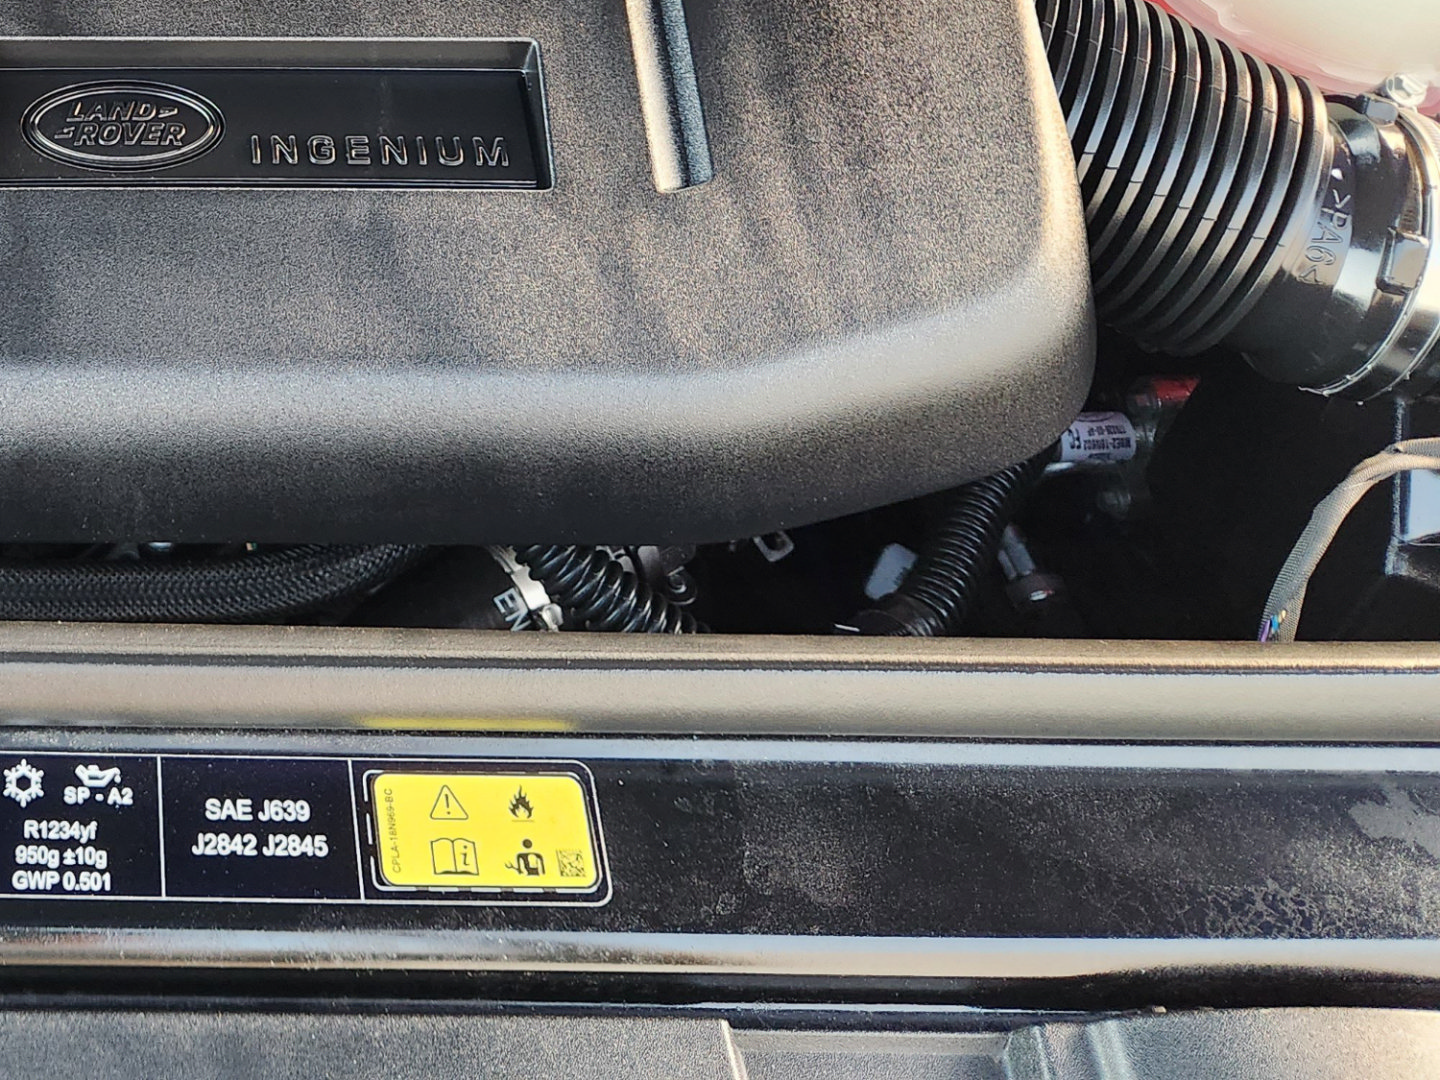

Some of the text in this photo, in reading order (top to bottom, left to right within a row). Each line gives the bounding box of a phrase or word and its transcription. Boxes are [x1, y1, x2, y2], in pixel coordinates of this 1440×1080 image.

[65, 101, 159, 122] LAND
[73, 121, 187, 147] ROVER
[250, 133, 510, 167] INGENIUM
[63, 787, 92, 805] SP
[106, 788, 134, 806] A2
[205, 798, 311, 822] SAE J639
[23, 819, 98, 841] R1234yf
[191, 833, 329, 858] J2842 J2845
[14, 847, 108, 869] 950g ±10g
[11, 871, 111, 892] GWP 0.501
